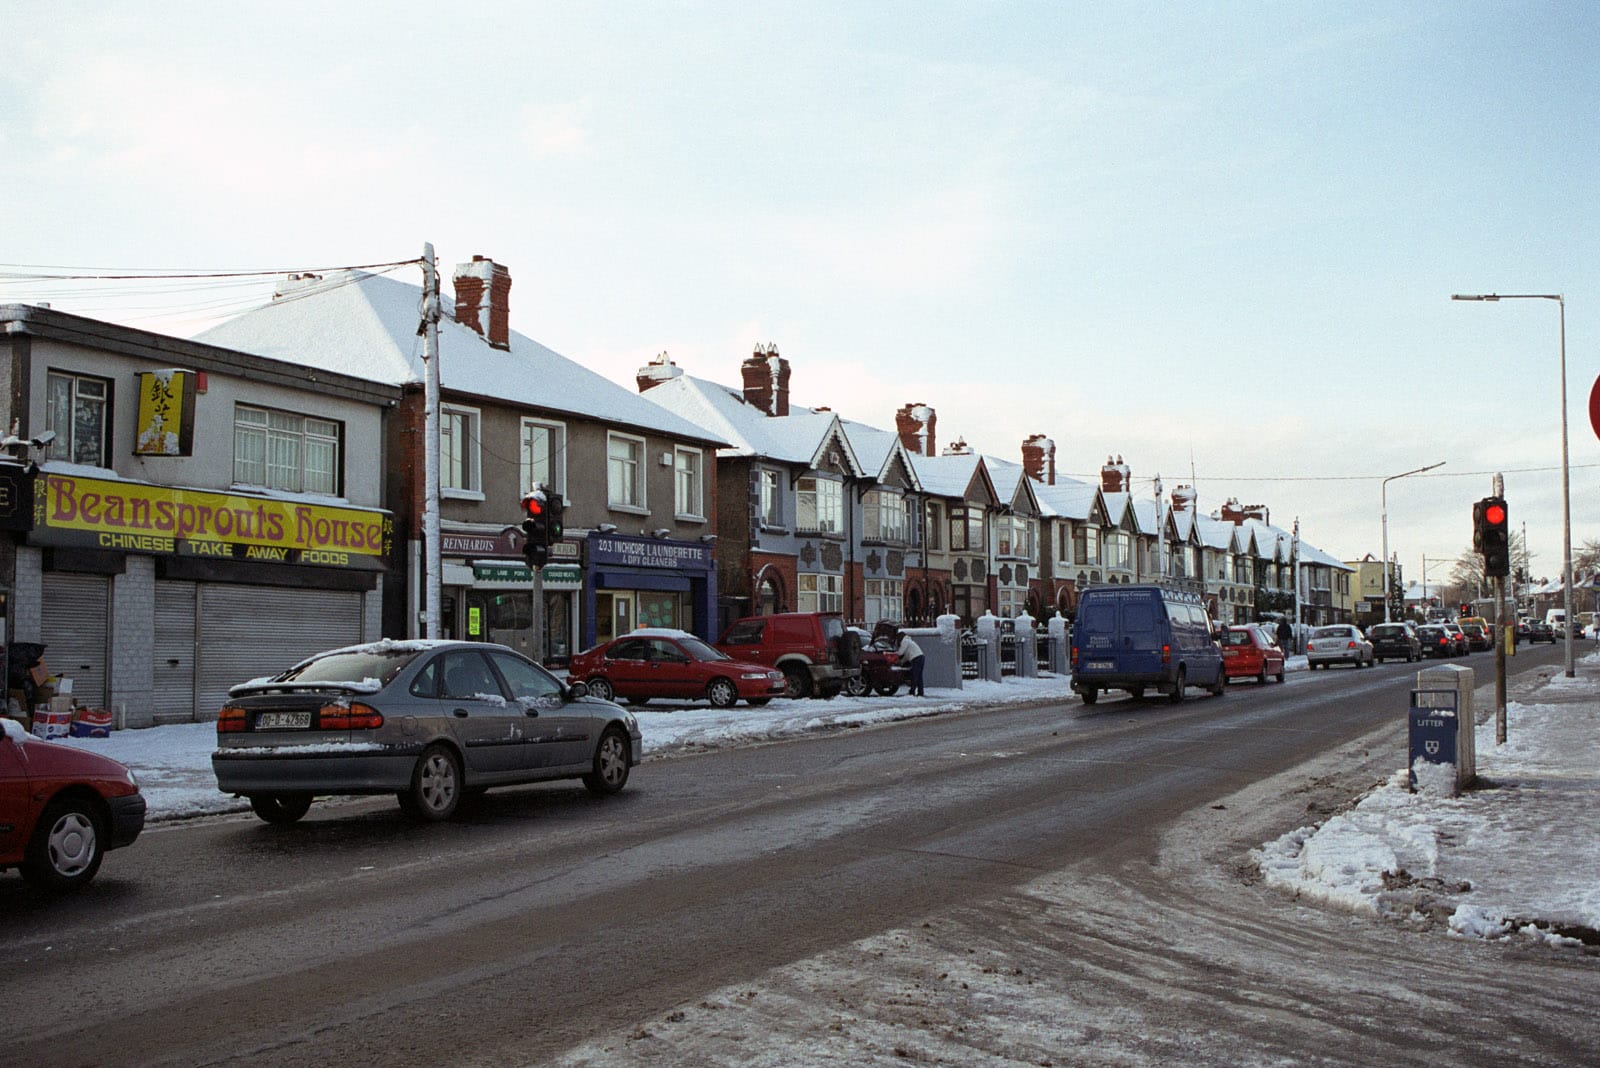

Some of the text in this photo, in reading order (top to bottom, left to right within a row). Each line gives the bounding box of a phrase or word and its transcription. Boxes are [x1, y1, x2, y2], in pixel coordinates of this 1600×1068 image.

[49, 477, 284, 541] Beansprouts
[100, 533, 349, 565] CHINESE TAKE AWAY FOODS
[443, 537, 495, 552] REINHARDTS
[614, 540, 645, 556] INCHICORE
[646, 544, 703, 560] LAUNDERETTE
[628, 556, 641, 565] DRY
[641, 556, 678, 568] CLEANERS
[1417, 719, 1444, 727] LITTER
